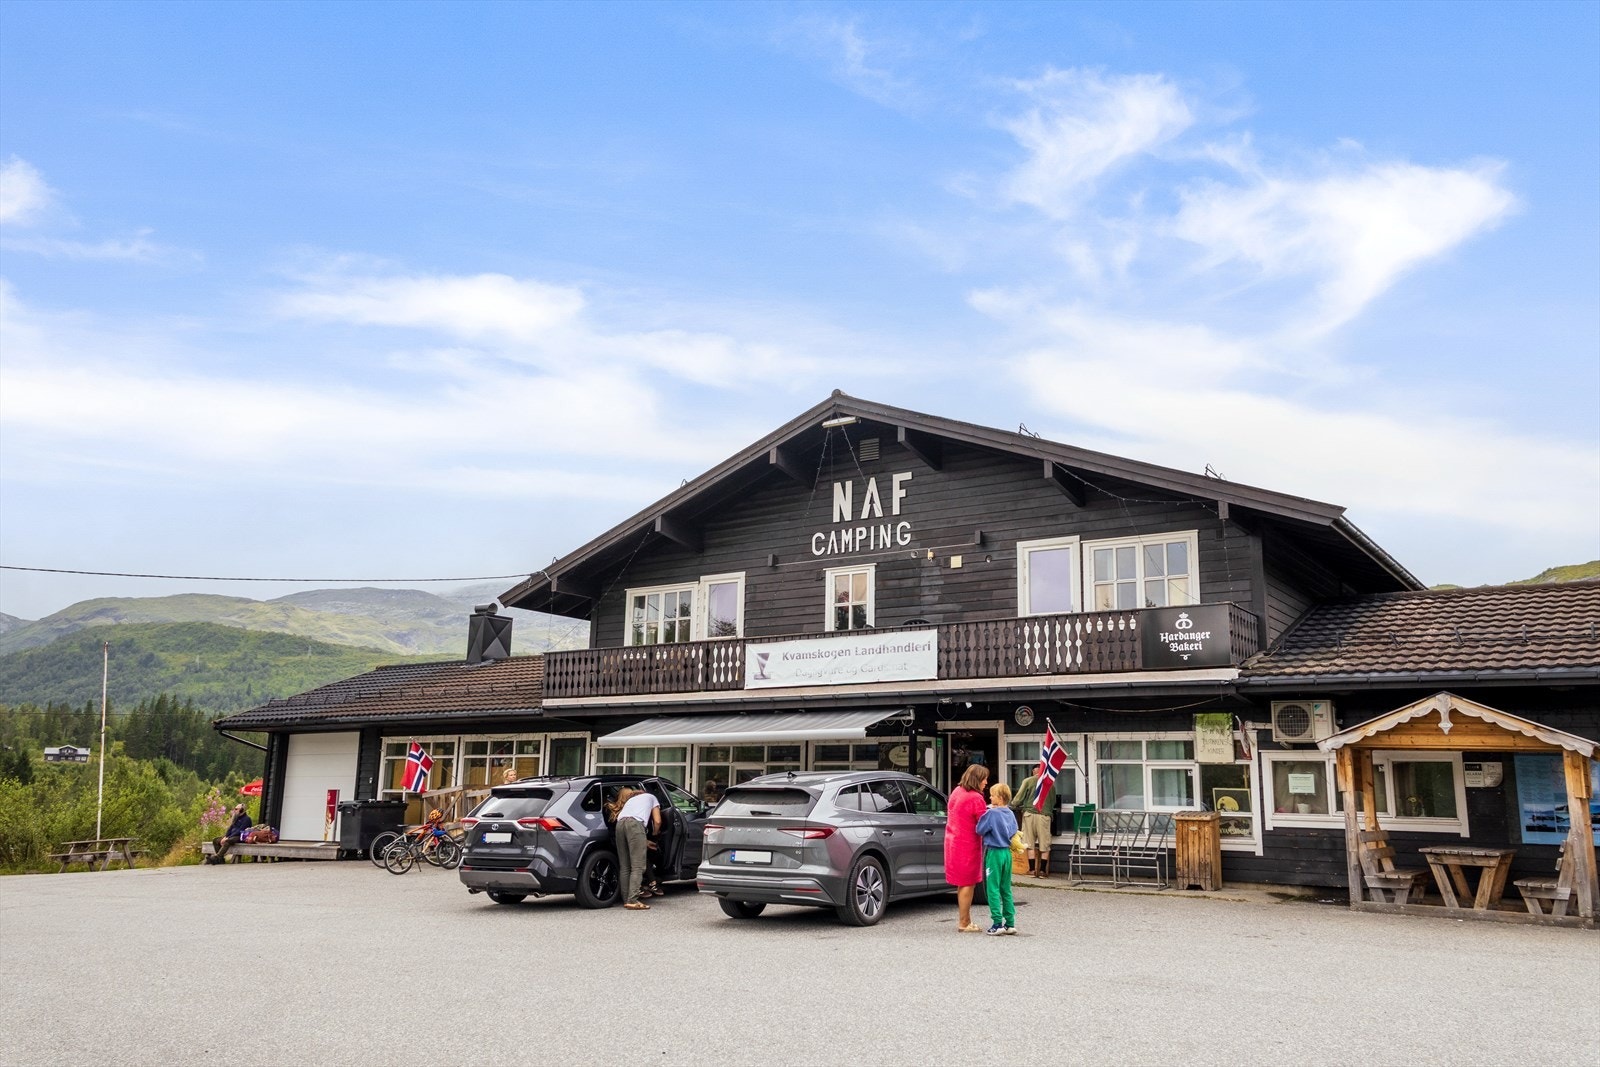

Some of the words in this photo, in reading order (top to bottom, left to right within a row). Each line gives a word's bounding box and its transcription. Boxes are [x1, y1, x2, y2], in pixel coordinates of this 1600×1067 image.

[833, 472, 912, 522] NAF
[812, 521, 911, 555] CAMPING
[1160, 631, 1211, 643] Hardanger
[1169, 641, 1203, 652] Bakeri
[782, 648, 851, 661] Kvamskogen
[855, 641, 931, 656] Landhandleri
